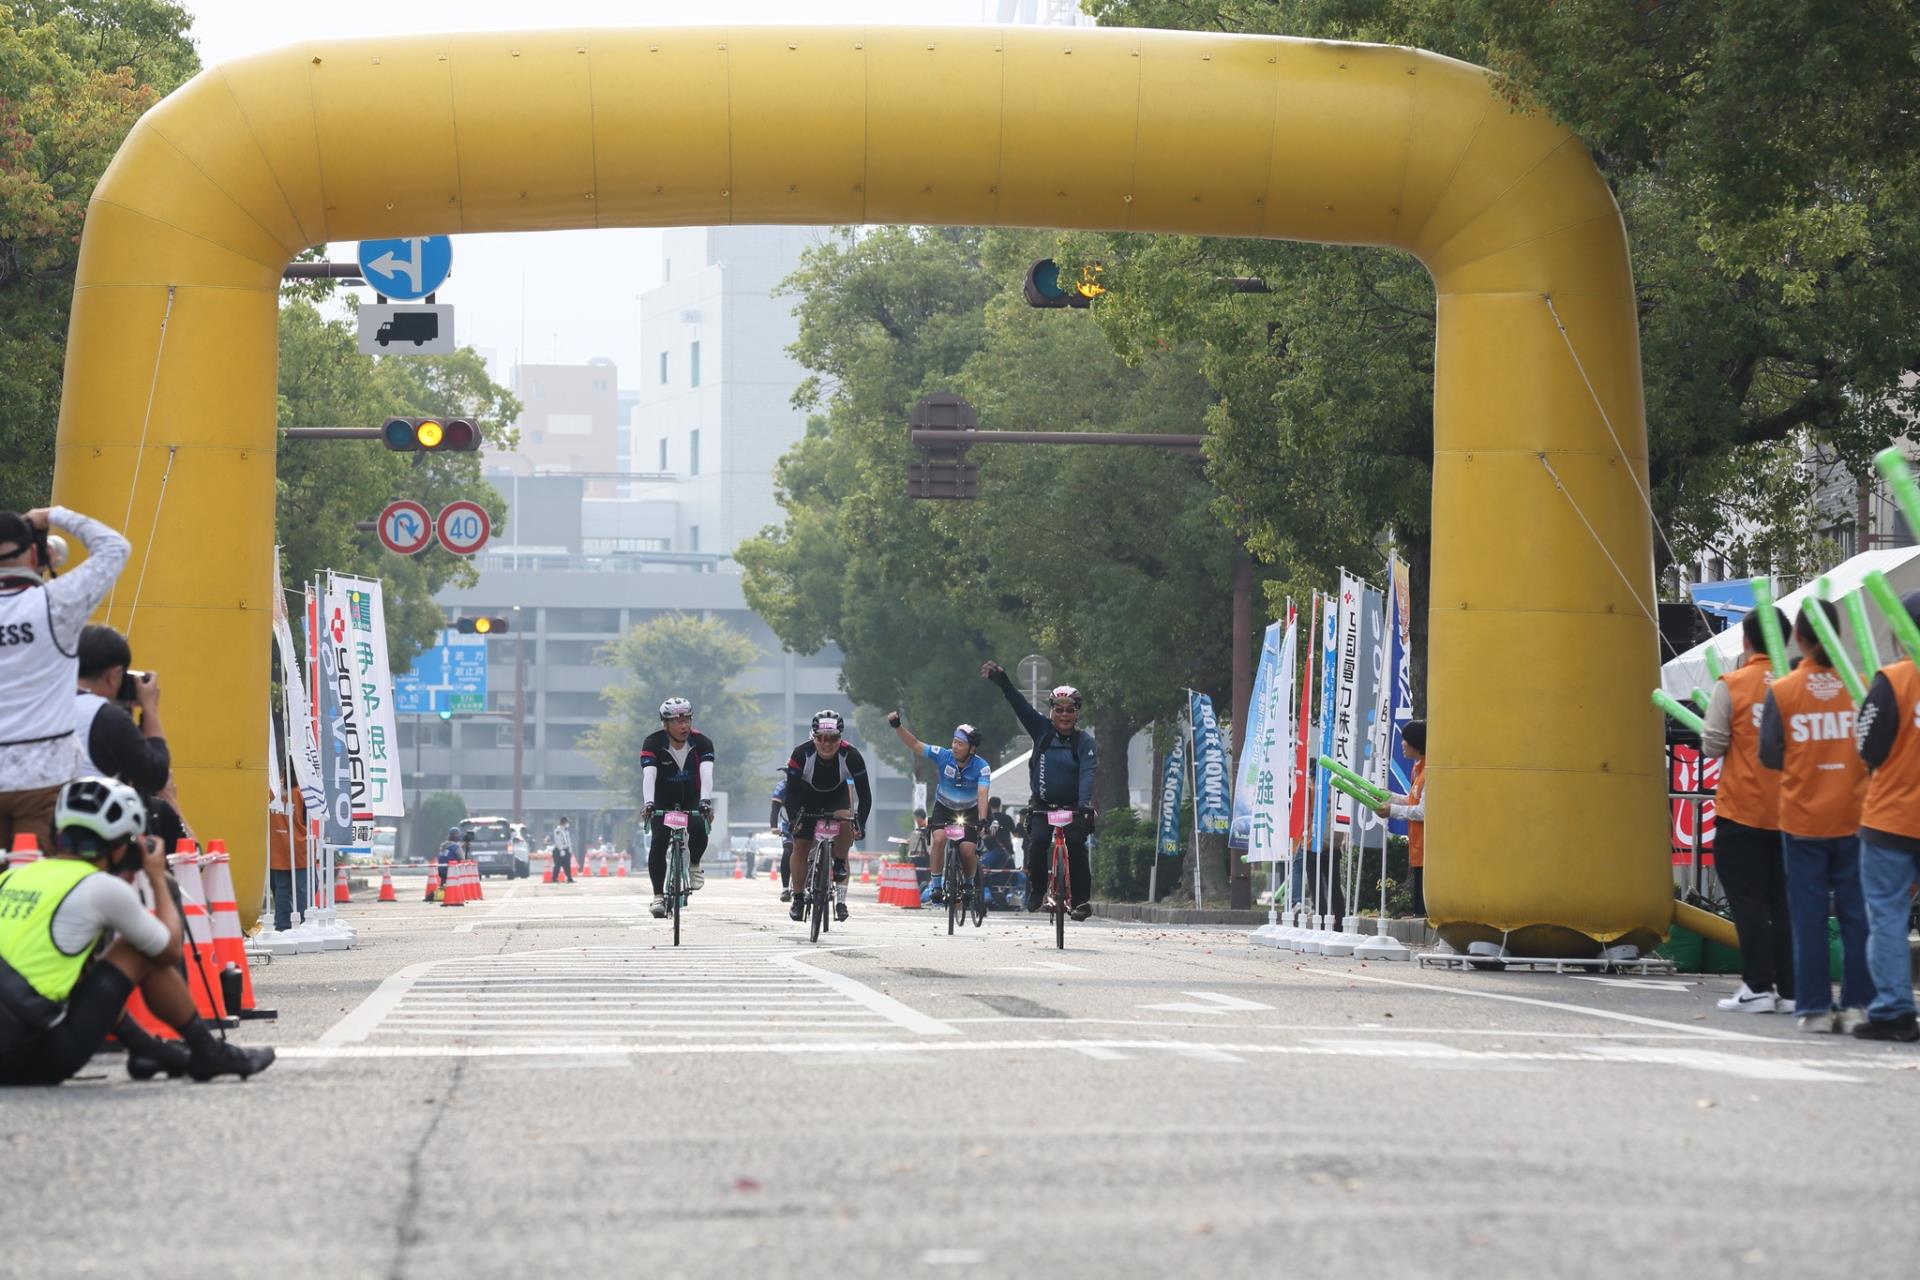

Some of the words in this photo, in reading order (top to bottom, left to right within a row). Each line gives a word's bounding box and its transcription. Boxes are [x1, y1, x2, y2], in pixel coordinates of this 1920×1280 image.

[449, 516, 478, 540] 40
[1200, 703, 1217, 729] DO
[1205, 733, 1219, 747] it
